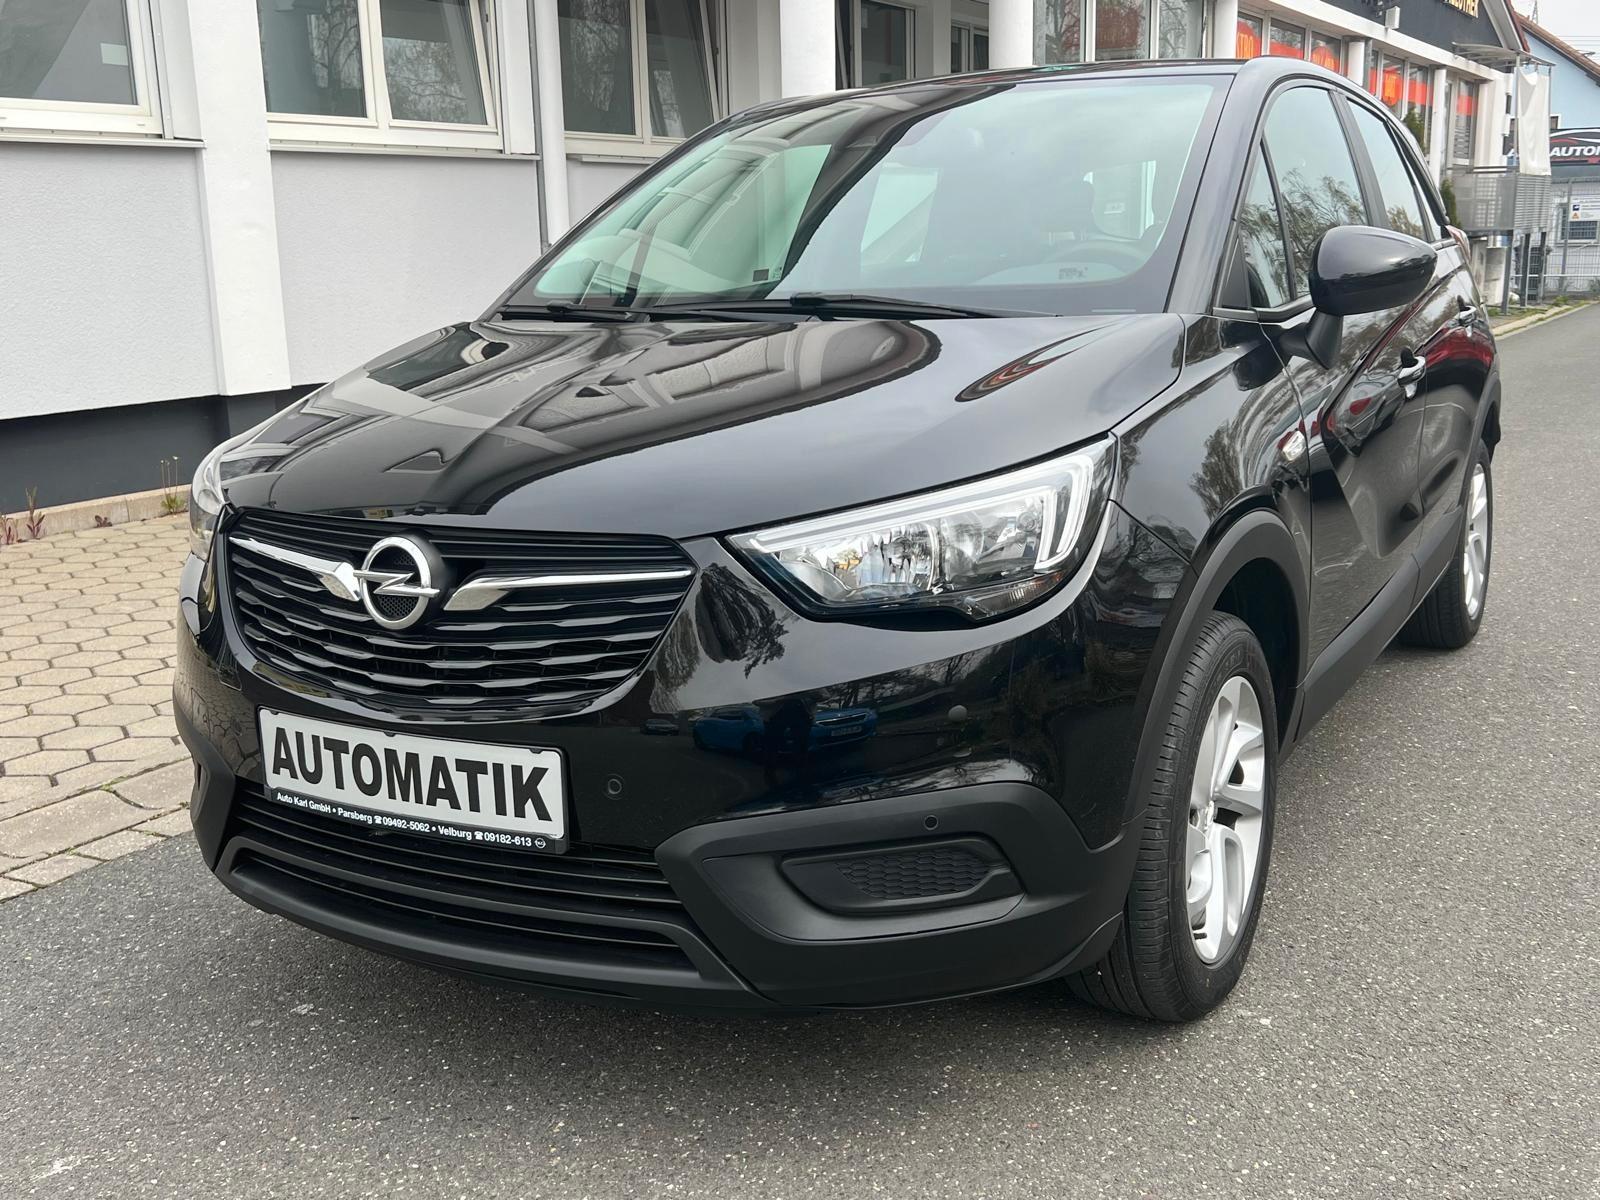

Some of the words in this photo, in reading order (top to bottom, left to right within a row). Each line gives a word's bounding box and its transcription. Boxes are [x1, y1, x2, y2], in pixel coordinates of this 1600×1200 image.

[272, 726, 552, 822] AUTOMATIK
[277, 792, 293, 804] Auto
[294, 797, 307, 808] Karl
[309, 801, 331, 814] GmbH
[338, 807, 373, 824] Parsberg
[382, 817, 430, 833] 09492-5062
[437, 825, 472, 841] Velburg
[484, 832, 532, 847] 09182-613
